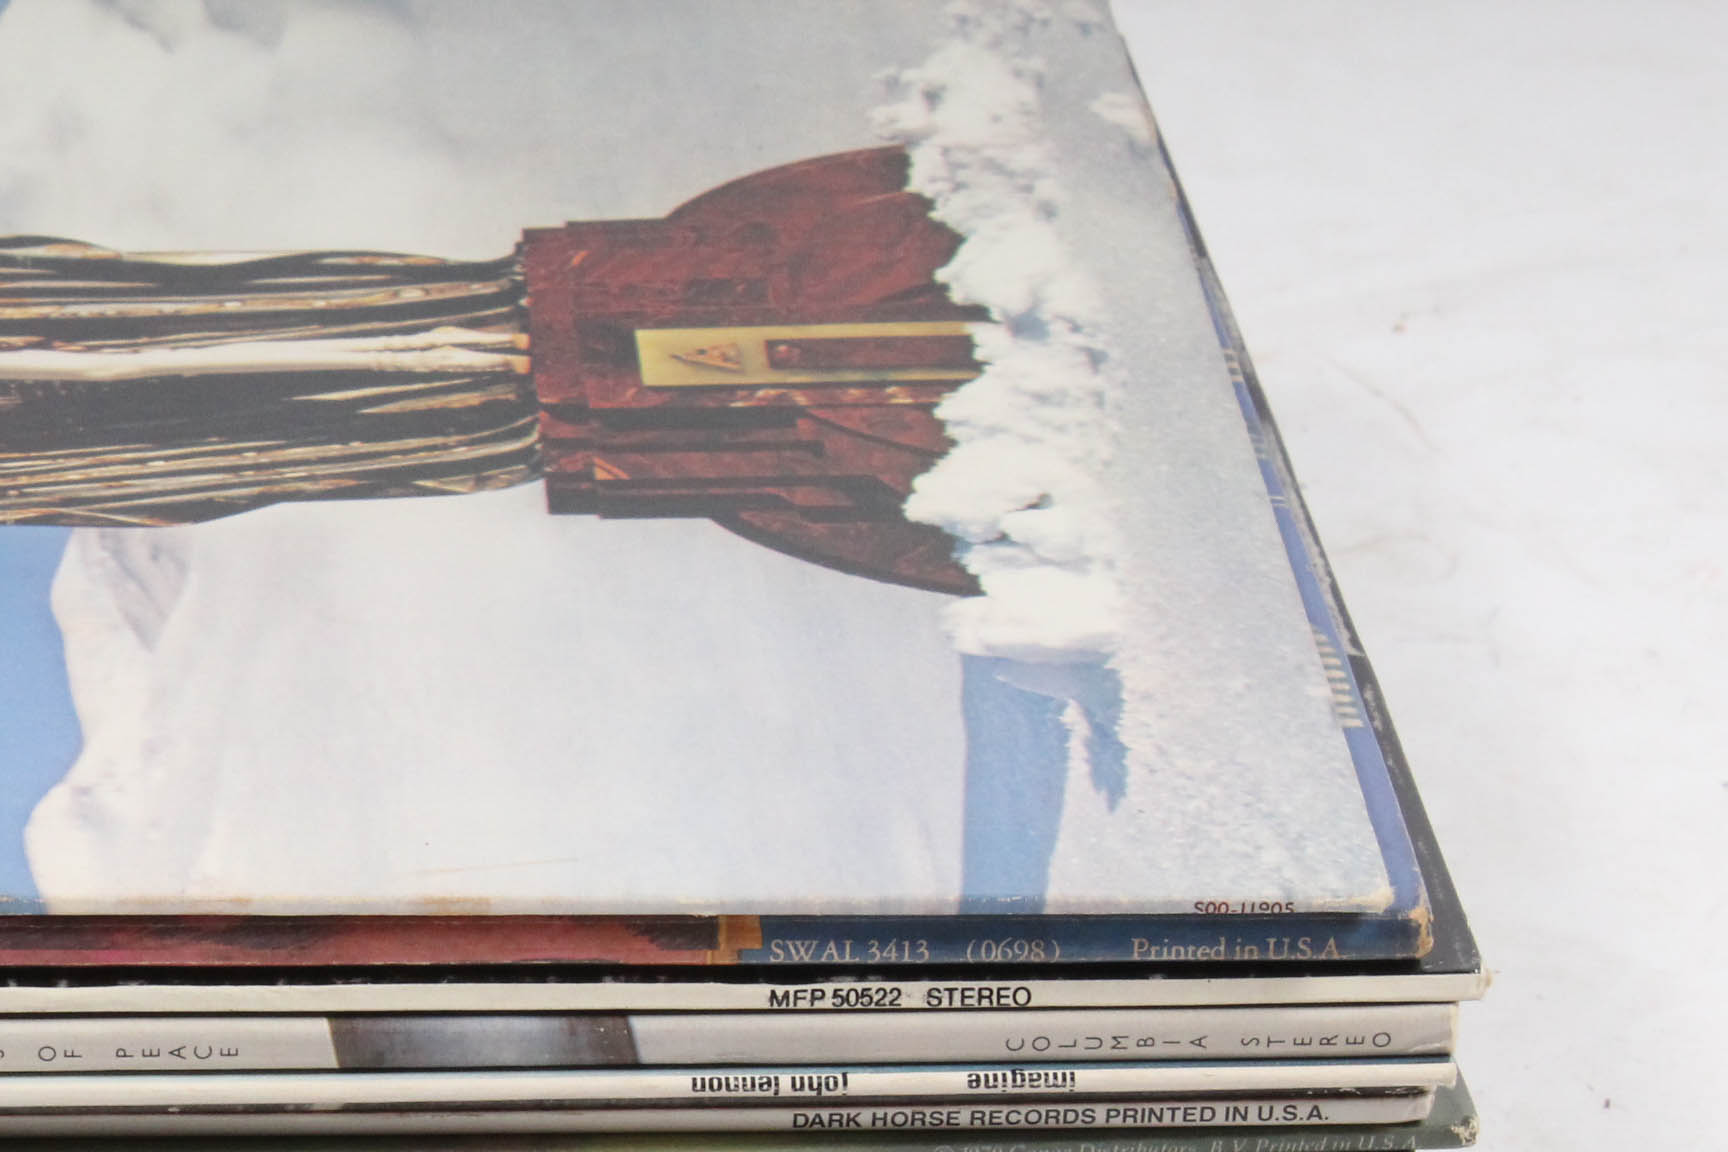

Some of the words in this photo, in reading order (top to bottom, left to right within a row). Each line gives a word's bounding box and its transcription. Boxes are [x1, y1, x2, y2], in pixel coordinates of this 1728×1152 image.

[867, 938, 930, 962] 3413
[966, 938, 1060, 963] (0698)
[1130, 936, 1226, 960] Printed
[1235, 937, 1259, 960] in
[1266, 936, 1348, 960] U.S.A.
[769, 989, 826, 1008] MFP
[831, 987, 903, 1008] 50522
[926, 986, 1032, 1007] STEREO
[37, 1046, 83, 1061] OF
[116, 1046, 240, 1060] PEACE
[1006, 1035, 1209, 1055] COLUMBIA
[1241, 1031, 1393, 1049] STEREO
[691, 1077, 779, 1096] lennon
[791, 1073, 849, 1095] john
[967, 1069, 1076, 1092] imagine
[793, 1113, 863, 1130] DARK
[872, 1111, 962, 1129] HORSE
[969, 1109, 1100, 1128] RECORDS
[1106, 1107, 1218, 1126] PRINTED
[1224, 1106, 1254, 1124] IN
[1259, 1105, 1330, 1123] U.S.A.
